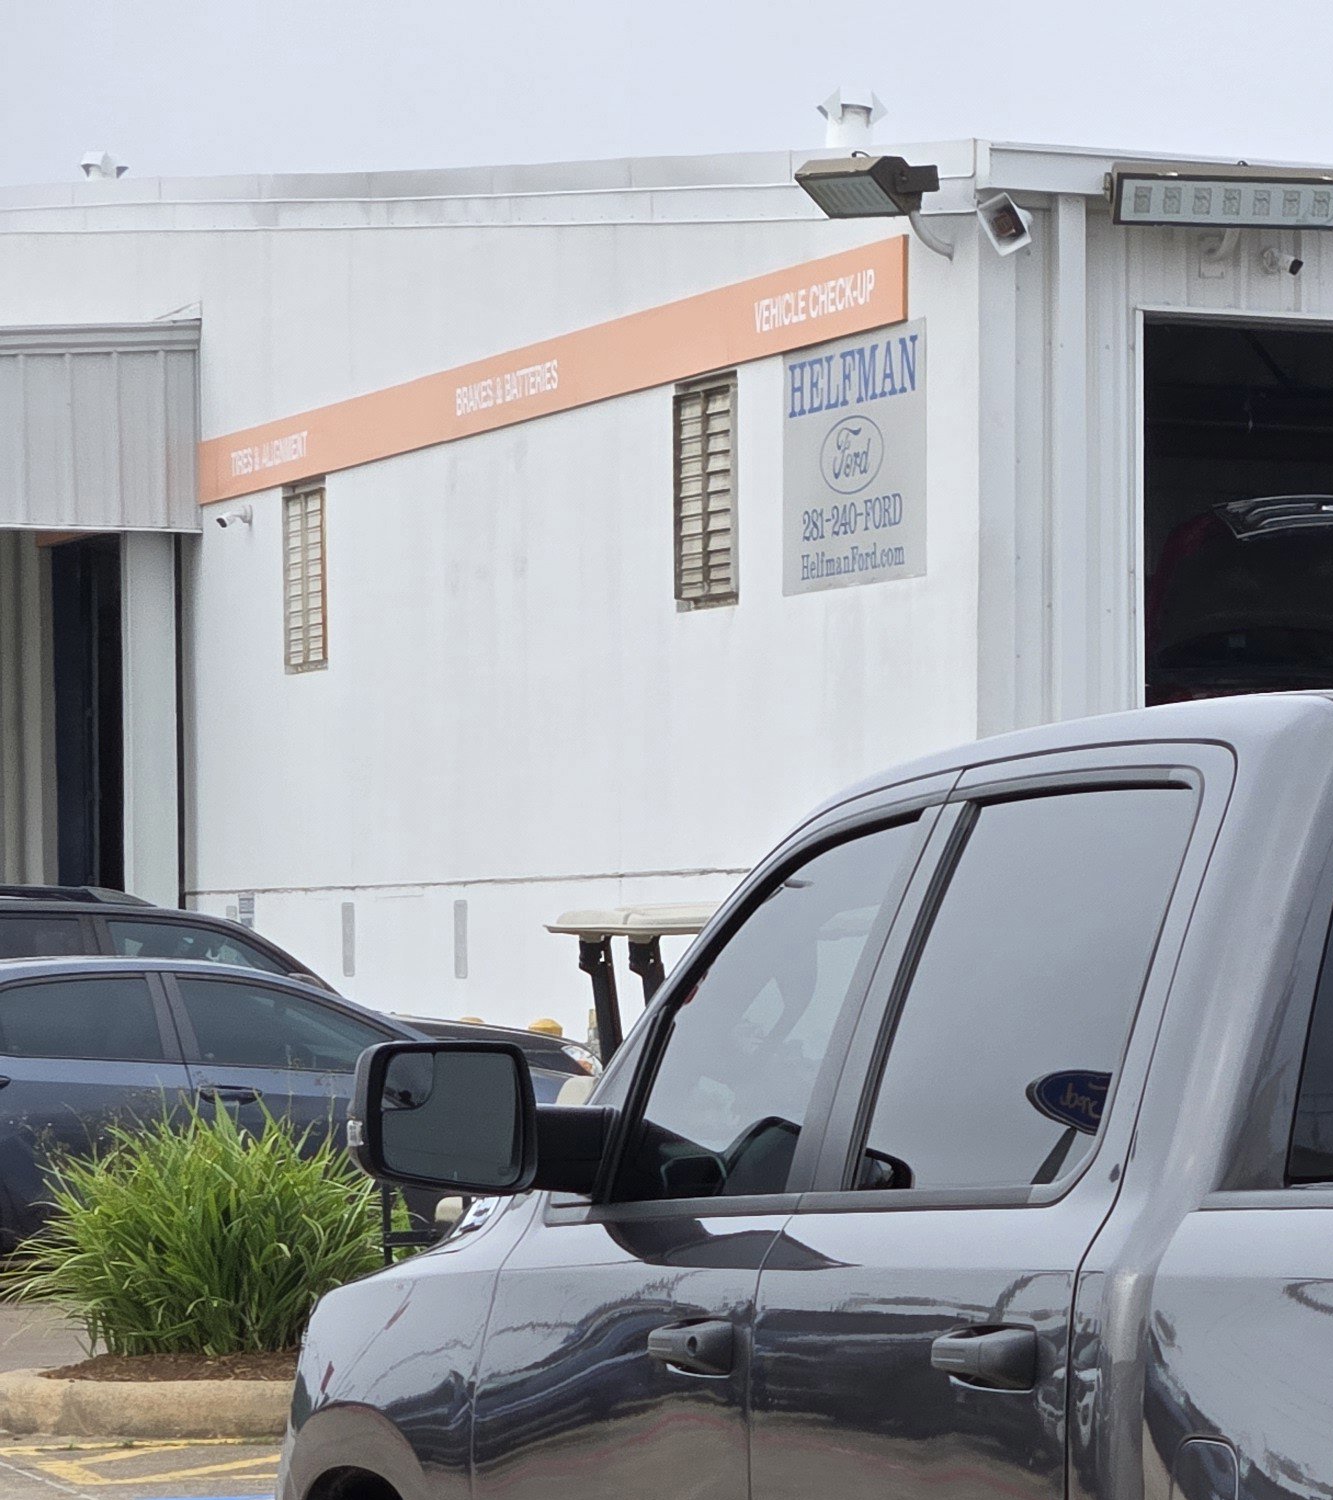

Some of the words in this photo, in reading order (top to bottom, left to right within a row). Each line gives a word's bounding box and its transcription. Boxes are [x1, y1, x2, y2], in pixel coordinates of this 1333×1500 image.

[754, 289, 806, 333] VEHICLE
[808, 268, 875, 319] CHECK-UP
[456, 378, 494, 416] BRAKES
[504, 359, 558, 401] BATTERIES
[788, 334, 918, 418] HELFMAN
[832, 427, 871, 480] Ford
[802, 493, 903, 541] 281-240-FORD
[800, 544, 905, 581] HelfmanFord.com
